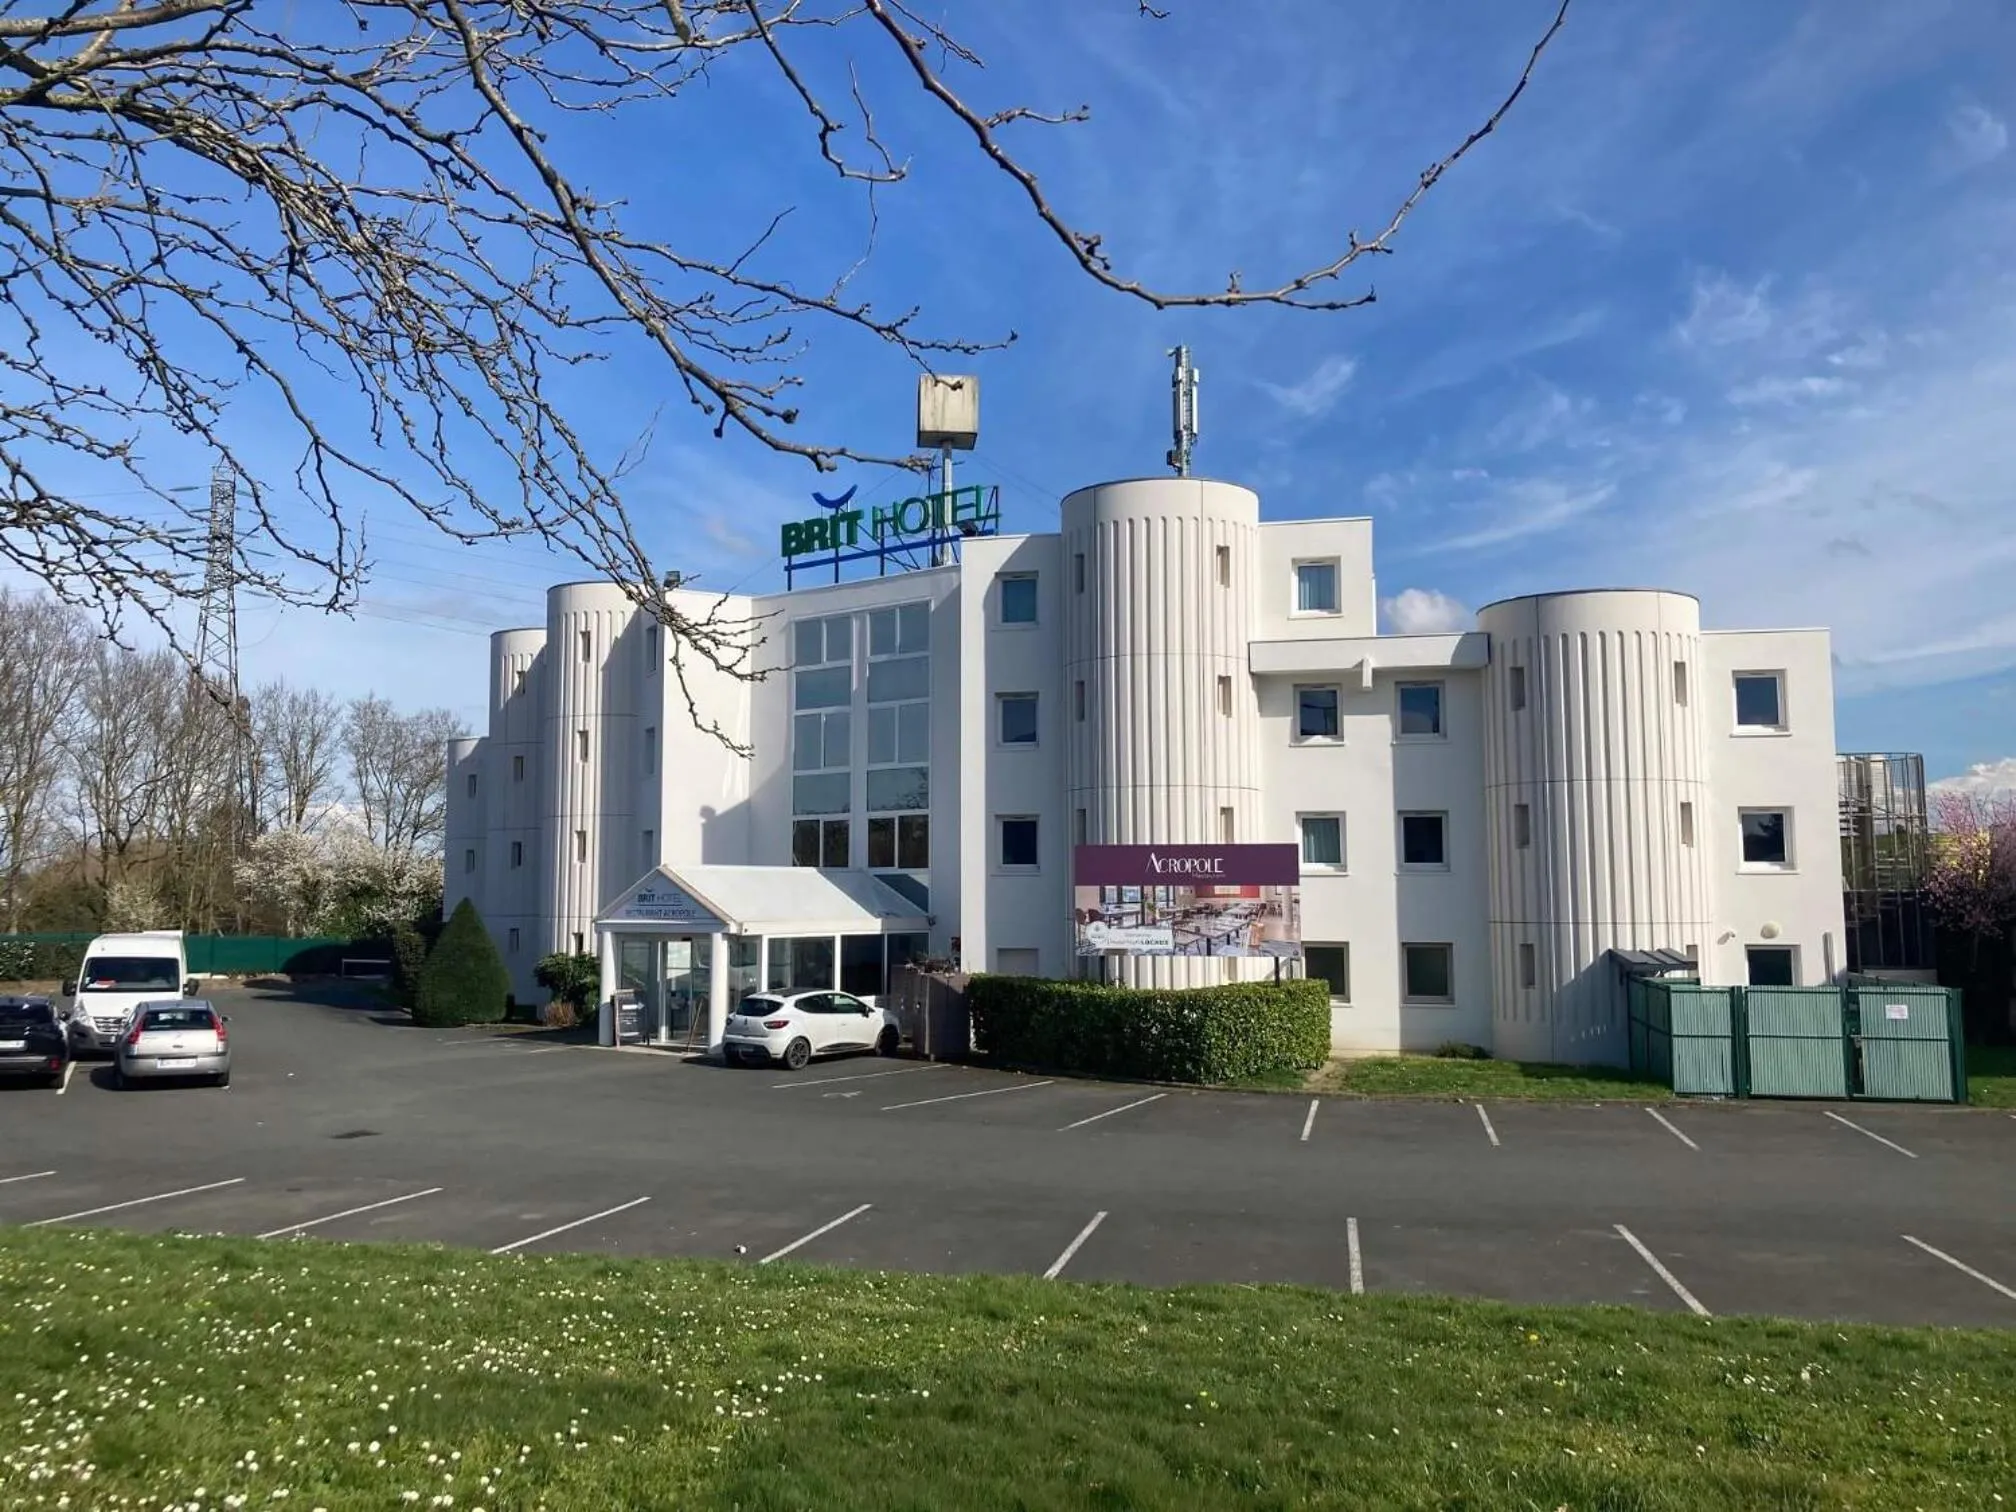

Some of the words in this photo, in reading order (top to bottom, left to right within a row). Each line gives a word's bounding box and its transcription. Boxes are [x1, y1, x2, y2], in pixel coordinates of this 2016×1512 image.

[781, 509, 864, 557] BRIT
[871, 484, 1002, 540] HOTEL
[1145, 852, 1224, 873] ACROPOLE
